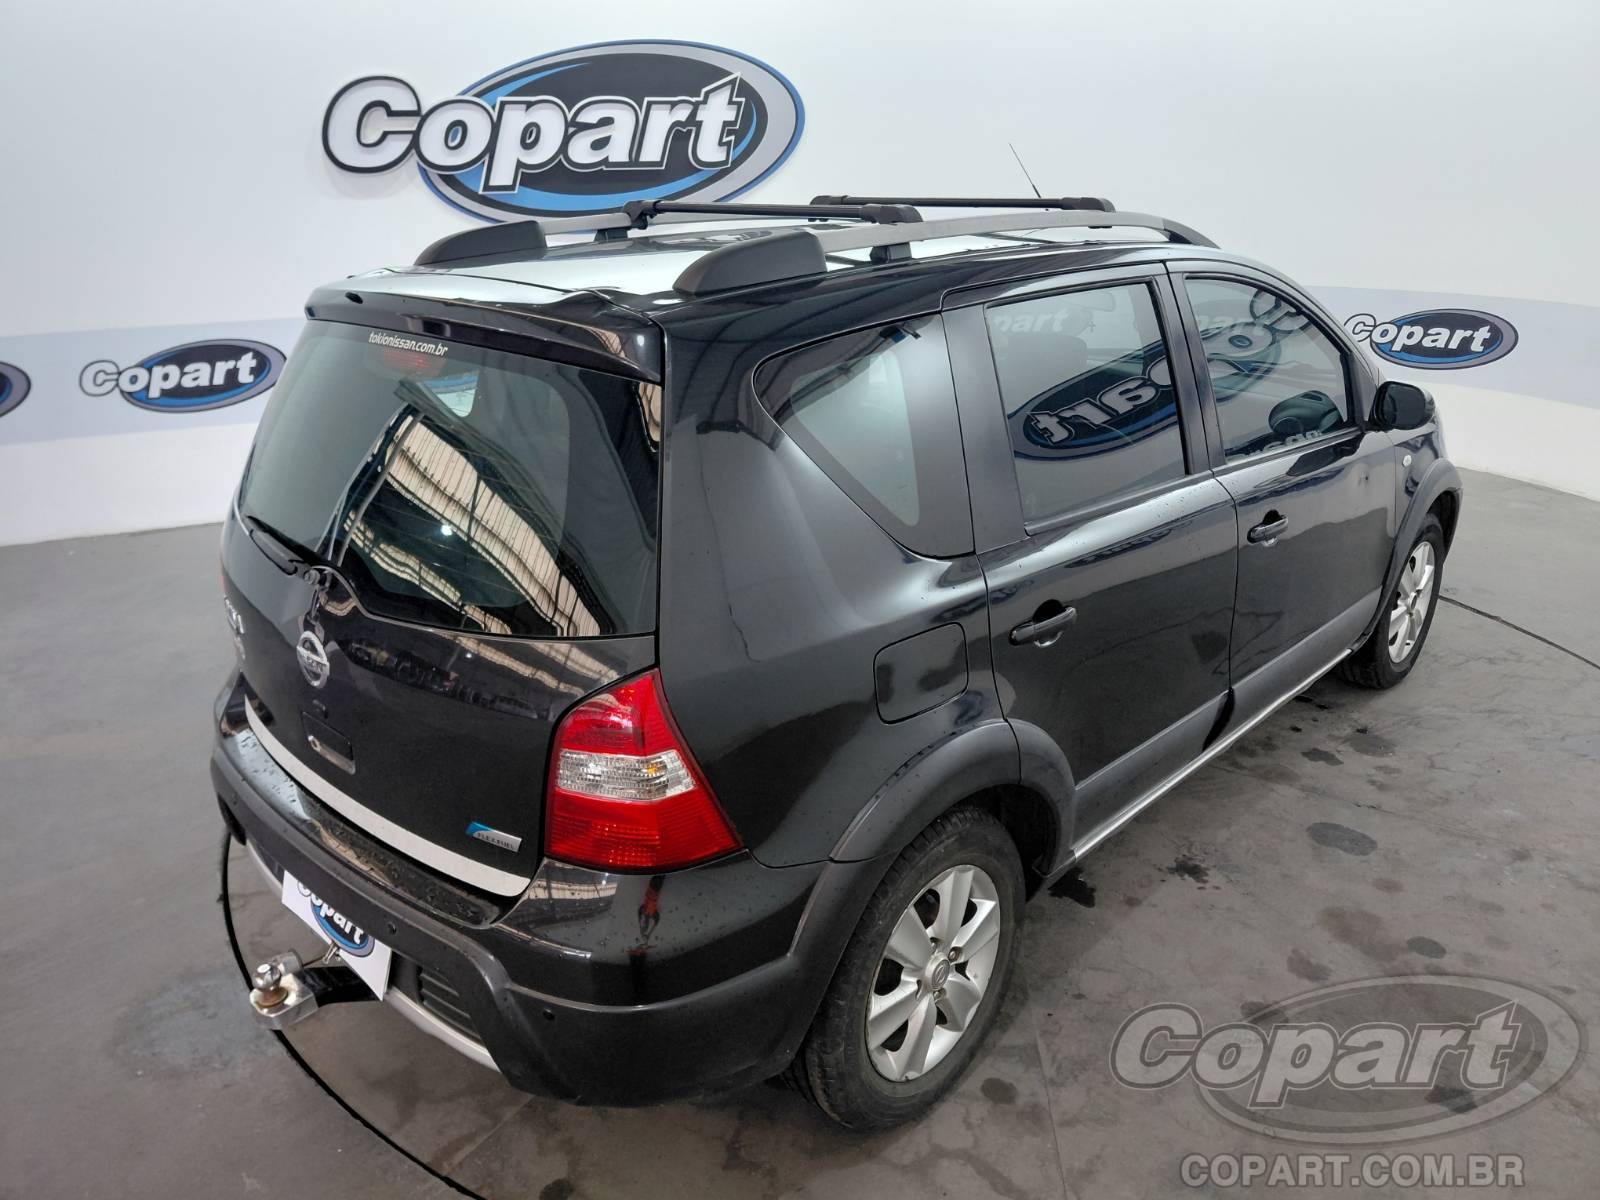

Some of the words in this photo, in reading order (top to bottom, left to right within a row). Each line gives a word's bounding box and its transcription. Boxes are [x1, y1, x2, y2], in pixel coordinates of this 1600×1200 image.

[322, 73, 744, 193] Copart
[368, 331, 448, 356] tokionissan.com.br
[1344, 313, 1491, 352] Copart
[79, 351, 257, 399] Copart
